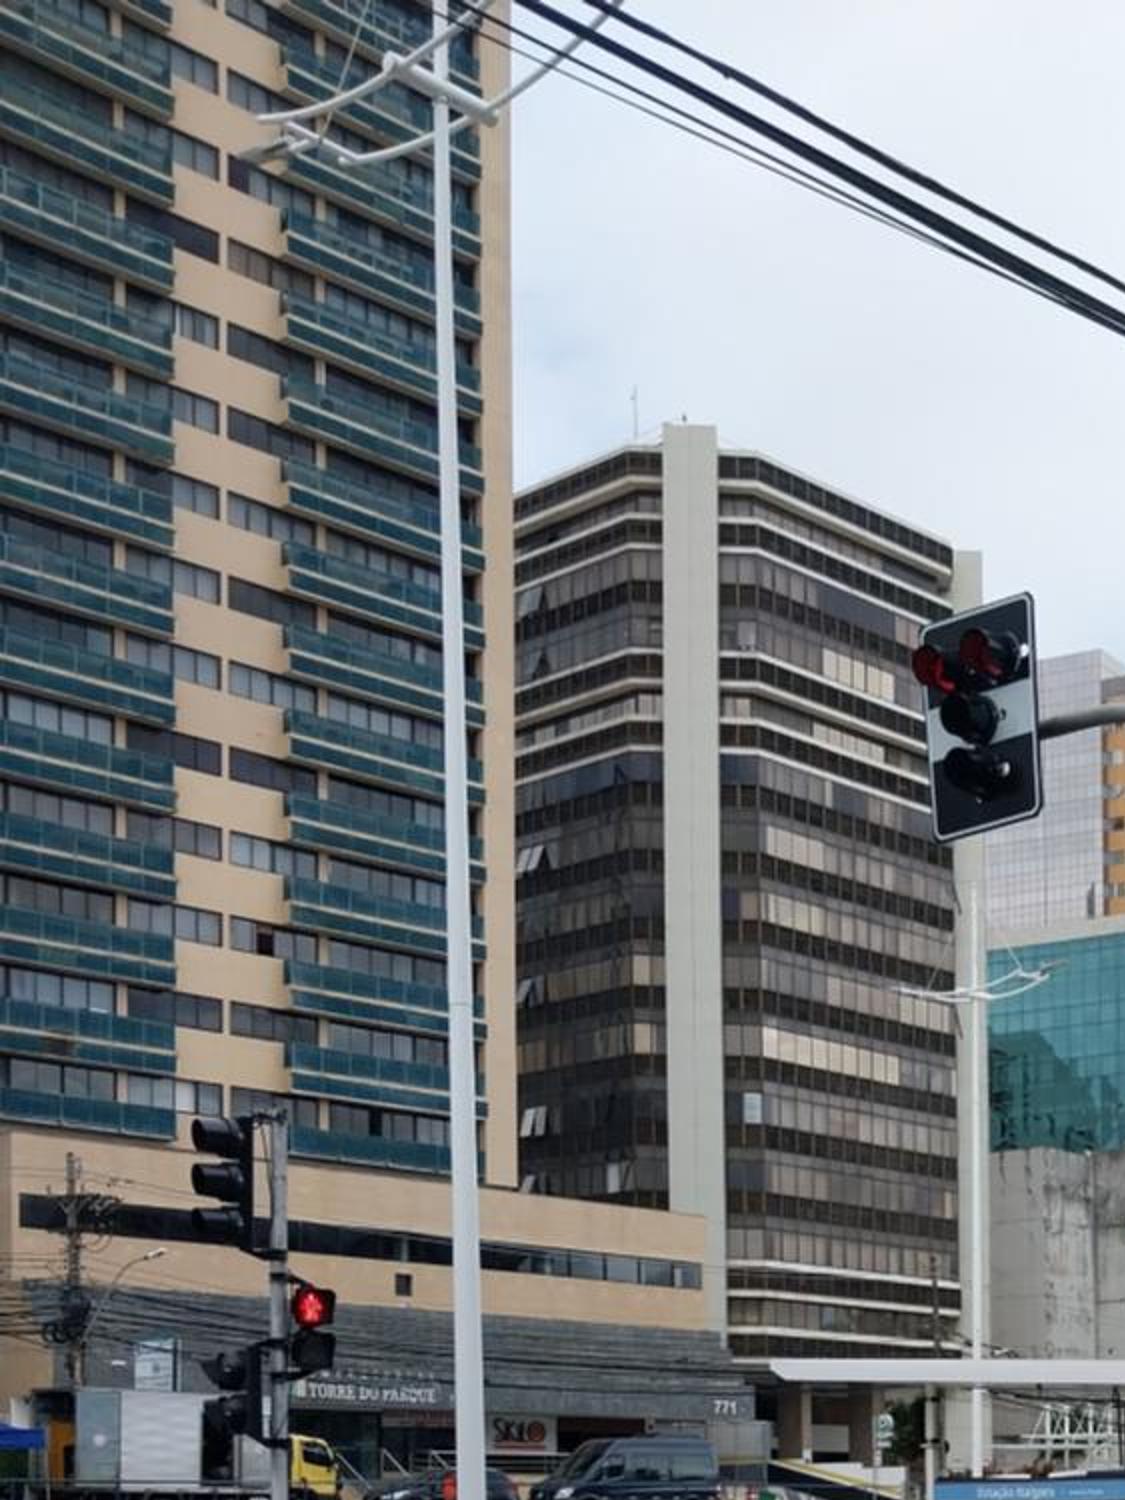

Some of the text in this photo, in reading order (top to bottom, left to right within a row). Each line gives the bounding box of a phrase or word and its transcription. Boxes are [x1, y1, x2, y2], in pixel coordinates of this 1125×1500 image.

[309, 1382, 436, 1404] TORRE DO PARQUE
[713, 1399, 737, 1415] 771
